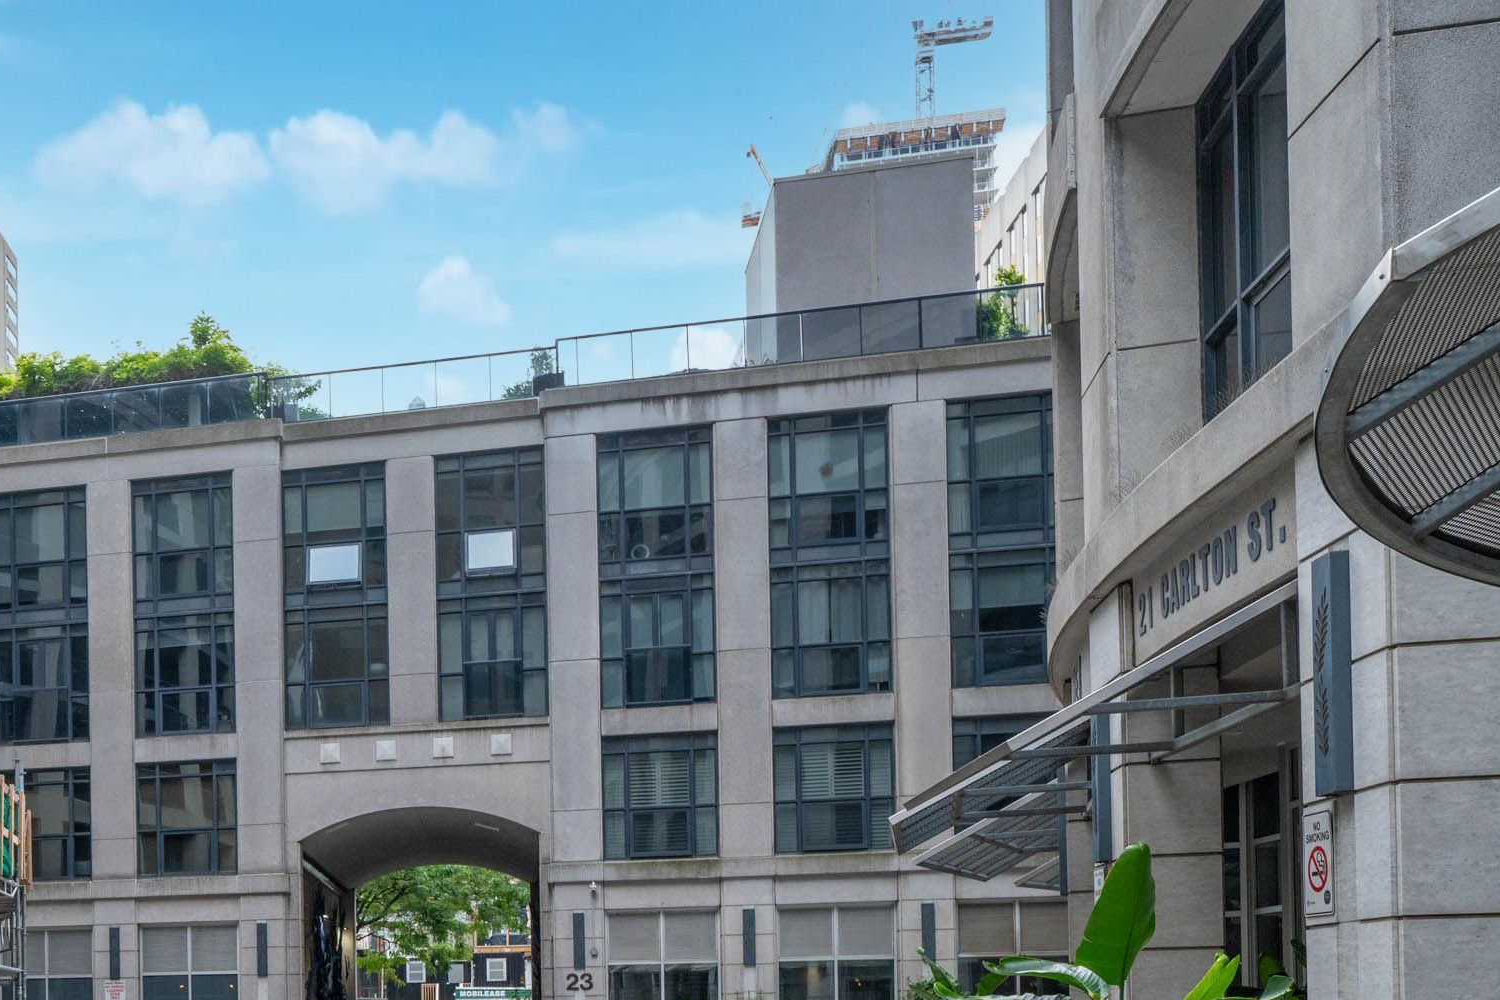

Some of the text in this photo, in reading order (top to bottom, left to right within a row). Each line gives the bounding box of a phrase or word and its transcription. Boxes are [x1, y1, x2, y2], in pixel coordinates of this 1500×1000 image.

[1139, 498, 1287, 637] 21 CARLTON ST.
[1312, 821, 1321, 832] NO
[1305, 830, 1330, 844] SMOKING
[566, 973, 594, 991] 23
[459, 990, 506, 998] MOBILEASE
